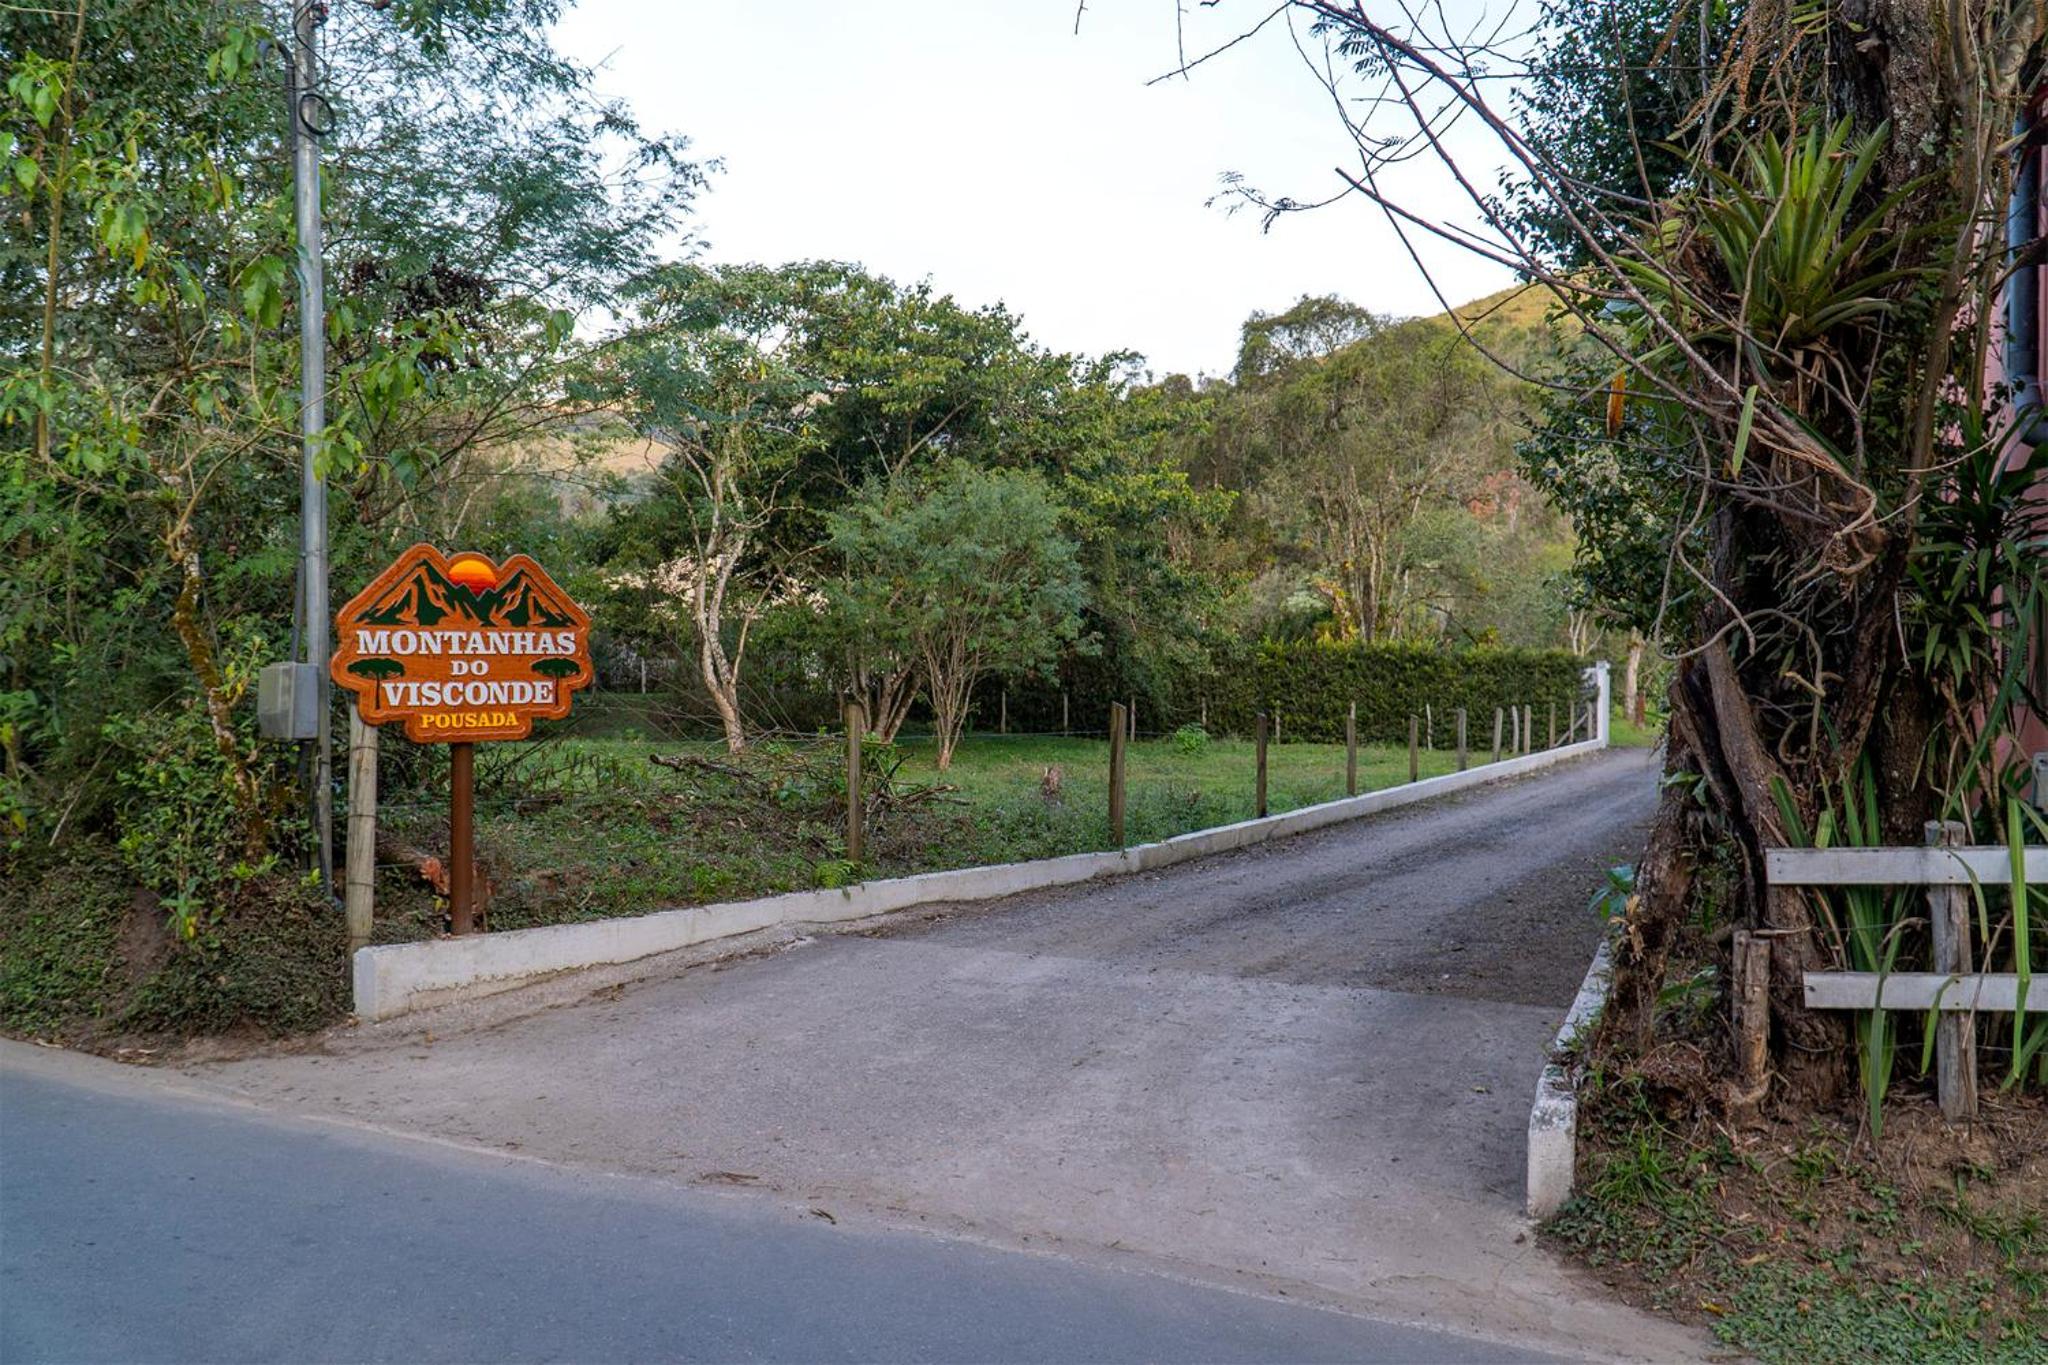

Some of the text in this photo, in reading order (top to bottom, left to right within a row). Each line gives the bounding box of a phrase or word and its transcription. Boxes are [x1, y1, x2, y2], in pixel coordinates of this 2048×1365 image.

[356, 630, 576, 655] MONTANHAS
[450, 660, 489, 675] DO
[382, 681, 554, 706] VISCONDE
[421, 712, 519, 728] POUSADA
